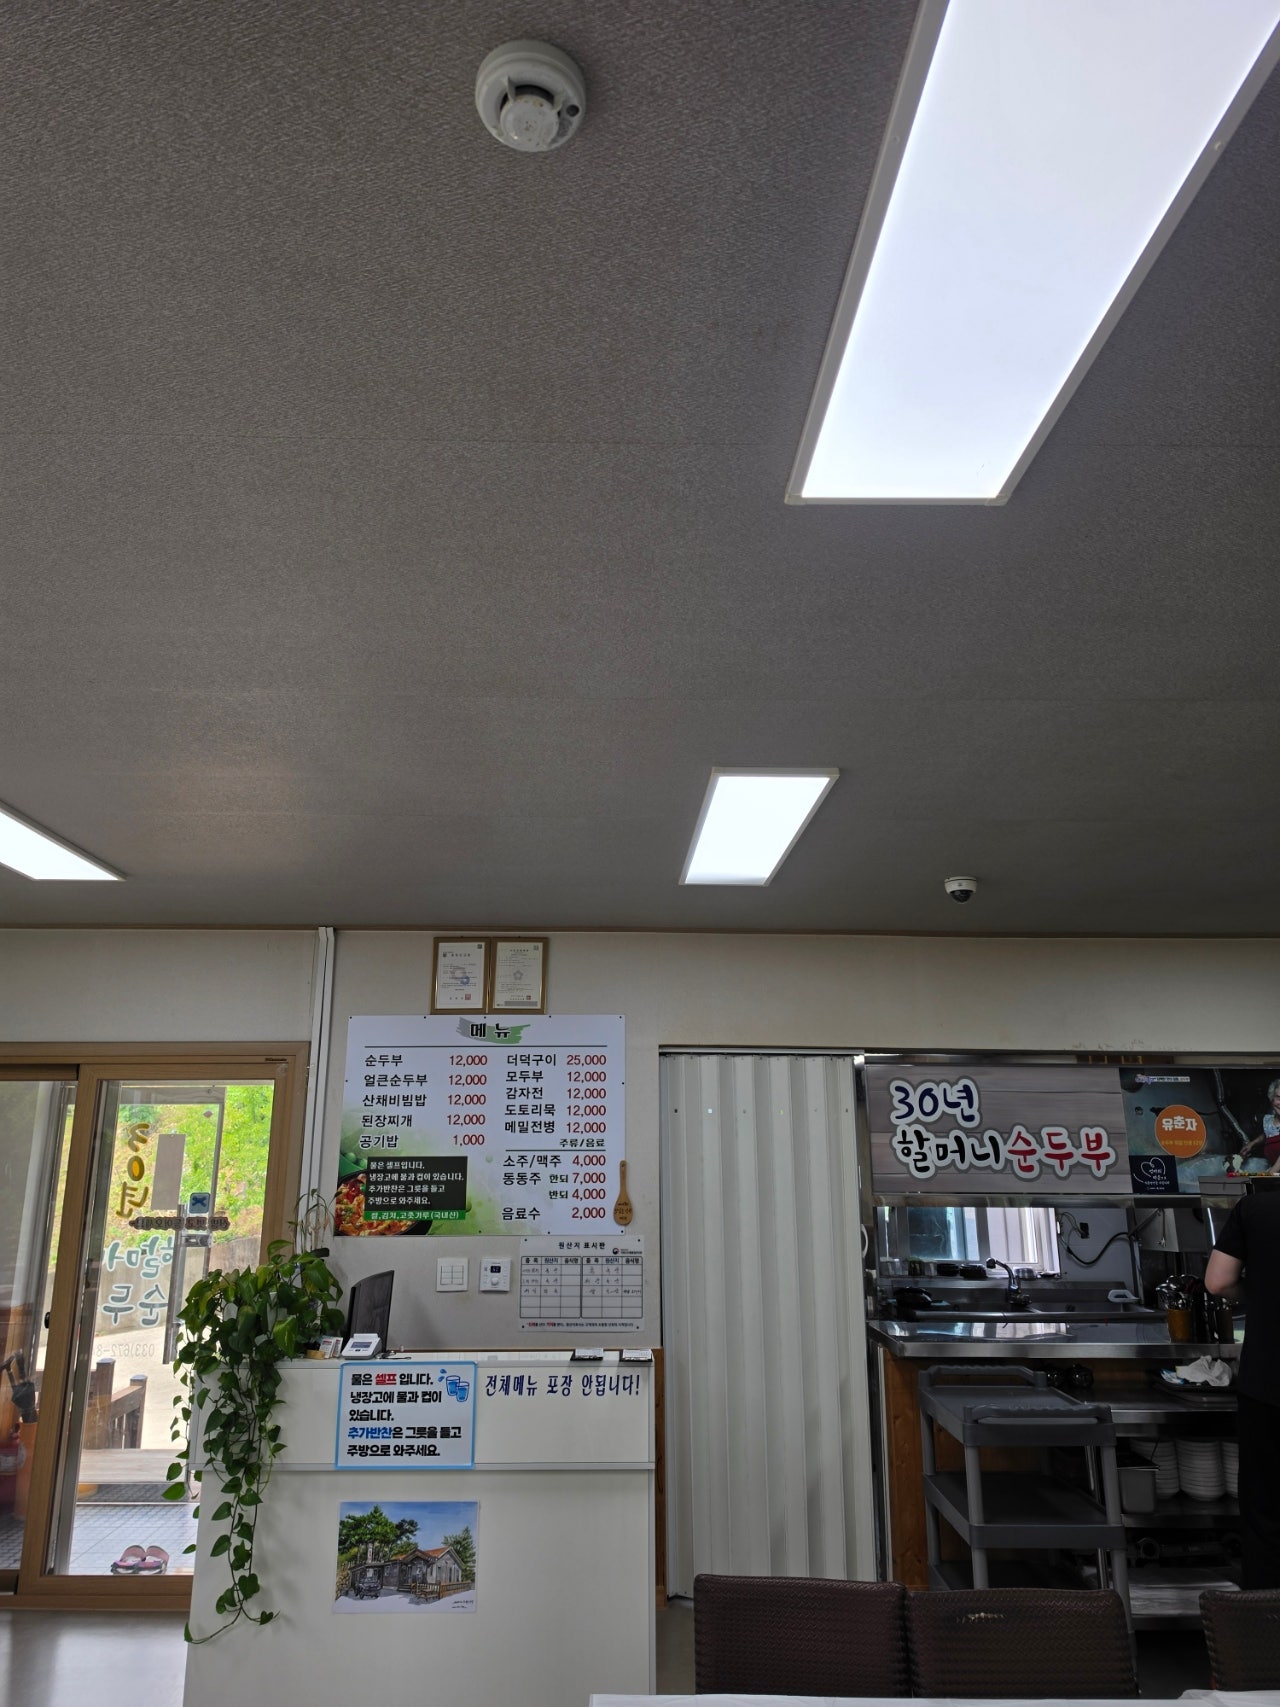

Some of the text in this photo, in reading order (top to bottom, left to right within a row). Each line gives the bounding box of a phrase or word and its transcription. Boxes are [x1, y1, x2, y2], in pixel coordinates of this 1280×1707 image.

[364, 1054, 488, 1067] 순두부 12,000
[507, 1054, 607, 1066] 더덕구이 25,000
[364, 1074, 487, 1087] 얼큰순두부 12,000
[505, 1070, 606, 1083] 모두부 12,000
[505, 1086, 606, 1100] 감자전 12,000
[362, 1094, 486, 1107] 산채비빔밥 12,000
[894, 1083, 975, 1123] 30년
[504, 1103, 606, 1117] 도토리묵 12,000
[361, 1114, 485, 1128] 된장찌개 12,000
[504, 1120, 606, 1134] 메밀전병 12,000
[1162, 1116, 1197, 1131] 유춘자
[360, 1134, 485, 1148] 공기밥 1,000
[560, 1139, 605, 1148] 주류/음료
[370, 1161, 384, 1170] 물은
[503, 1154, 606, 1168] 소주/맥주 4,000
[369, 1173, 464, 1181] 냉장고에 물과 컵이 있습니다.
[503, 1172, 606, 1185] 동동주 한되 7,000
[368, 1185, 445, 1193] 추가반찬은 그릇을 들고
[548, 1188, 606, 1201] 반되 4,000
[368, 1196, 431, 1205] 주방으로 와주세요.
[502, 1207, 540, 1221] 음료수
[571, 1207, 606, 1219] 2,000
[558, 1242, 606, 1250] 원산지 표시판
[351, 1373, 434, 1386] 물은 셀프 입니다.
[485, 1375, 640, 1396] 전체메뉴 포장 안됩니다!
[350, 1391, 442, 1404] 냉장고에 물과 컵이
[349, 1409, 394, 1421] 있습니다.
[347, 1426, 462, 1439] 추가반찬은 그릇을 들고
[347, 1444, 441, 1457] 주방으로 와주세요.
